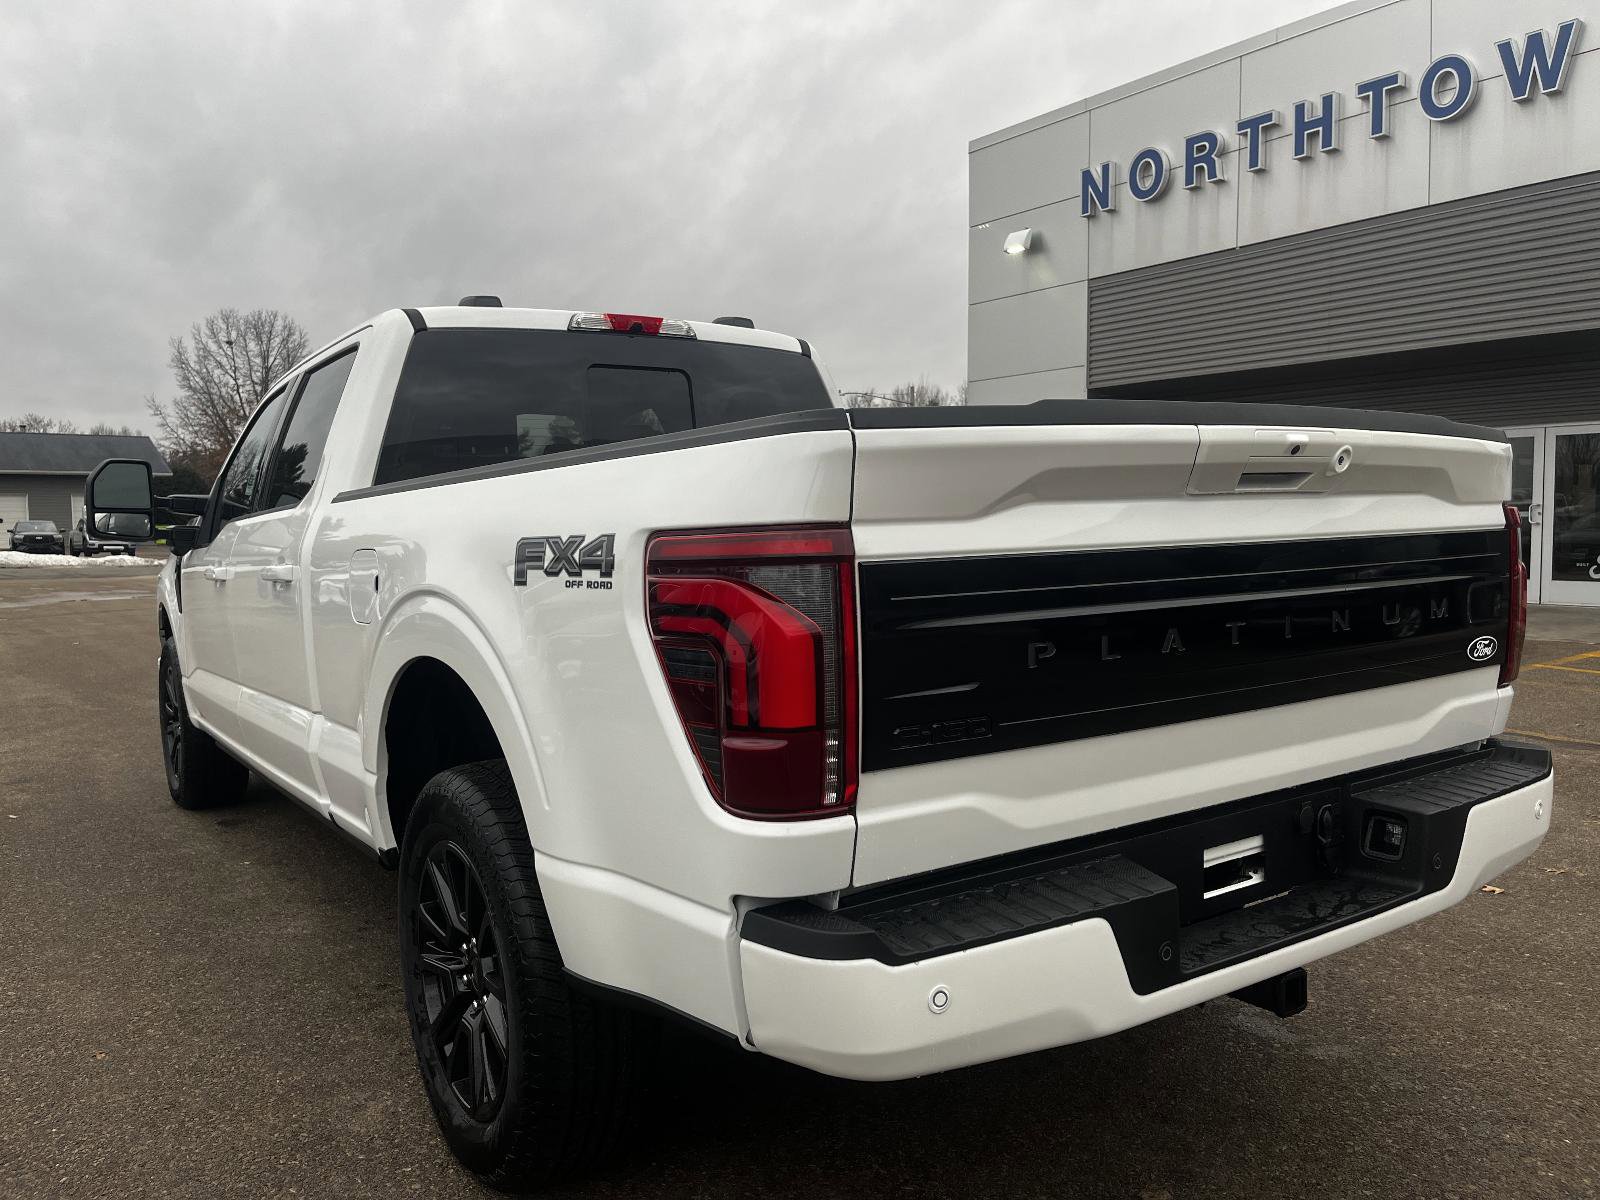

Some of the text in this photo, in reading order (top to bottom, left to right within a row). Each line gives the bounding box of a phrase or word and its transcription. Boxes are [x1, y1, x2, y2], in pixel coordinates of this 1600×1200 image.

[1080, 18, 1585, 218] NORTHTOW
[514, 533, 616, 586] FX4
[565, 580, 613, 589] OFF ROAD
[1028, 596, 1449, 669] PLATINUM
